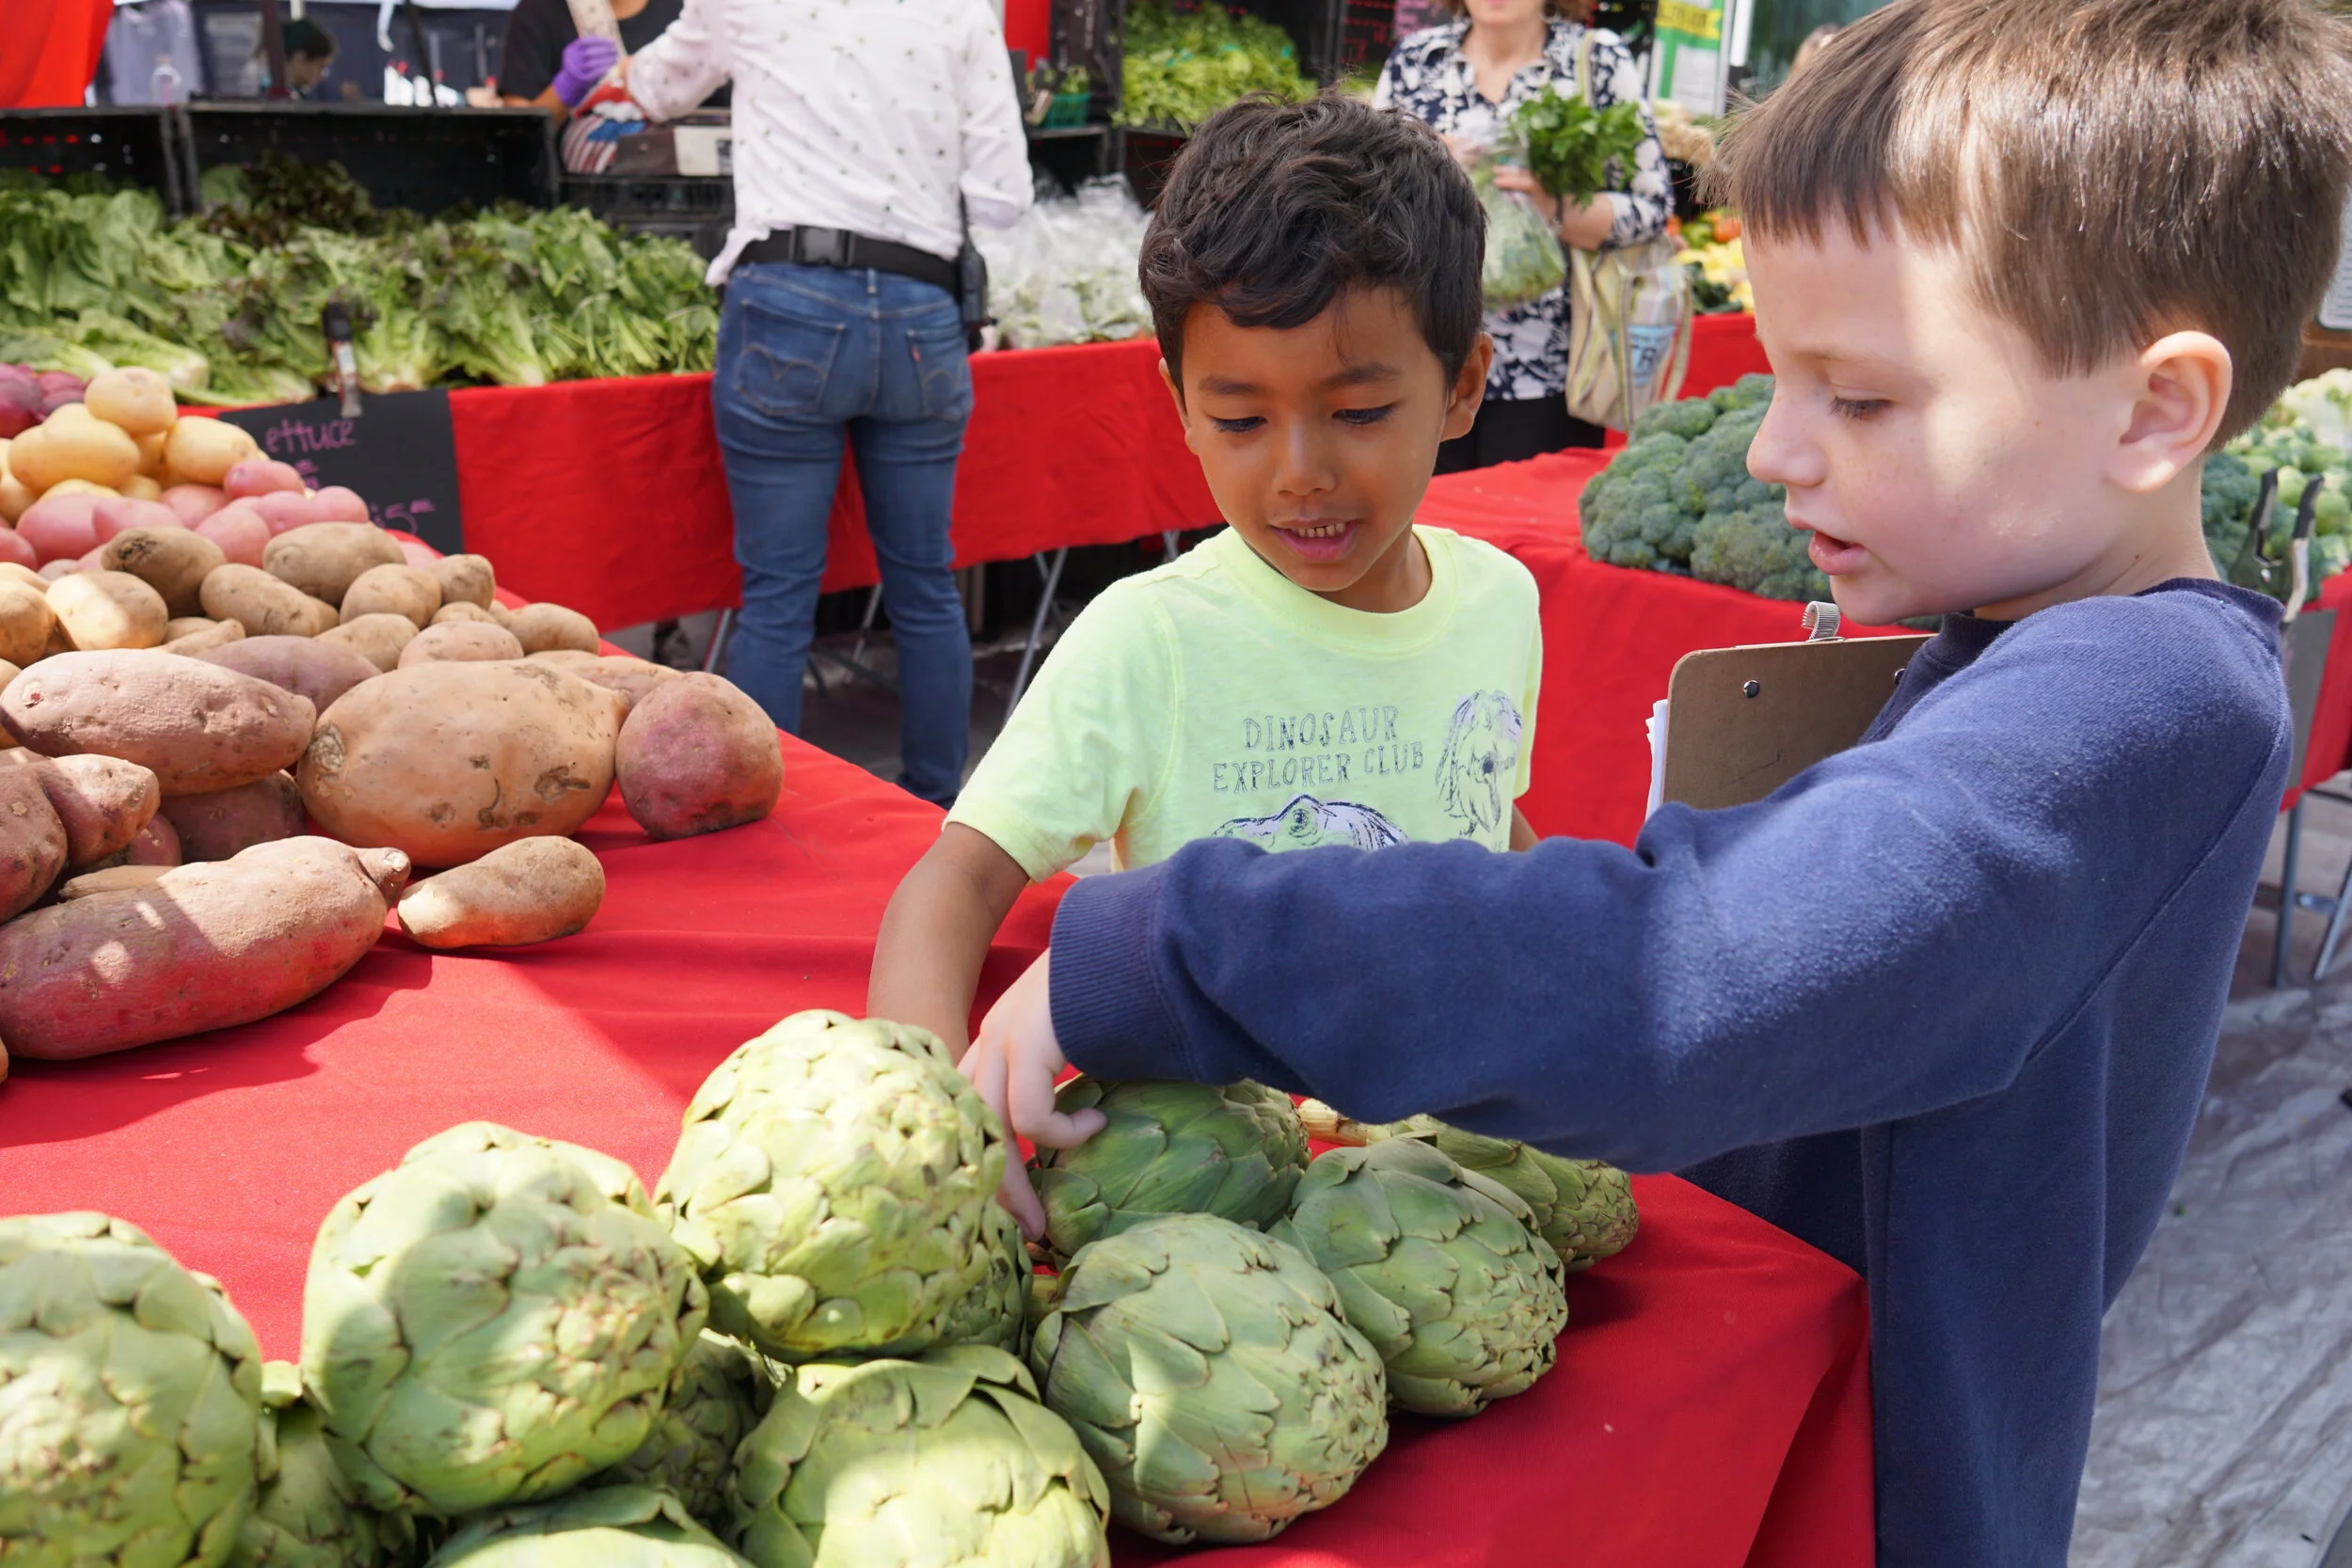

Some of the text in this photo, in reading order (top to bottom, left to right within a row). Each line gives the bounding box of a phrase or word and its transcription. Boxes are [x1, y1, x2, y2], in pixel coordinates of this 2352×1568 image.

[263, 419, 357, 454] ettuce
[1243, 705, 1398, 752] DINOSAUR
[1213, 741, 1423, 793] EXPLORER CLUB
